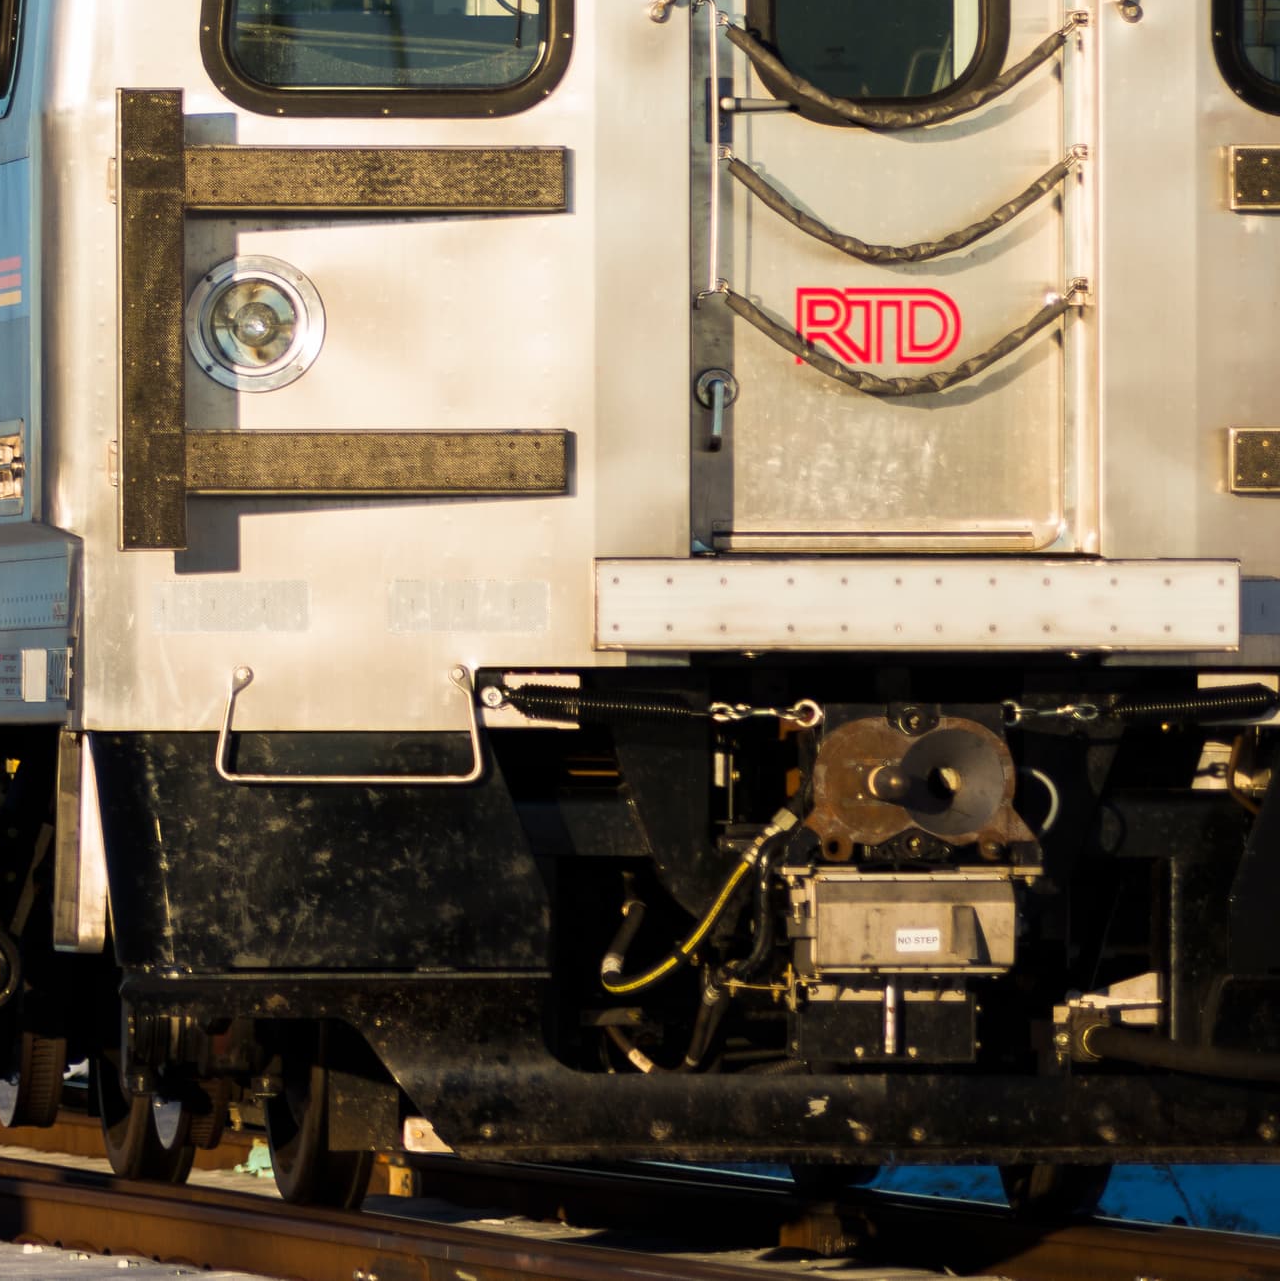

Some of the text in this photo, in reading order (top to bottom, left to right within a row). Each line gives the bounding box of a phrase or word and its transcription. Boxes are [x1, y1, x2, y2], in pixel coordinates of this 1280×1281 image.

[796, 287, 962, 364] RTD
[897, 935, 938, 945] NO STEP
